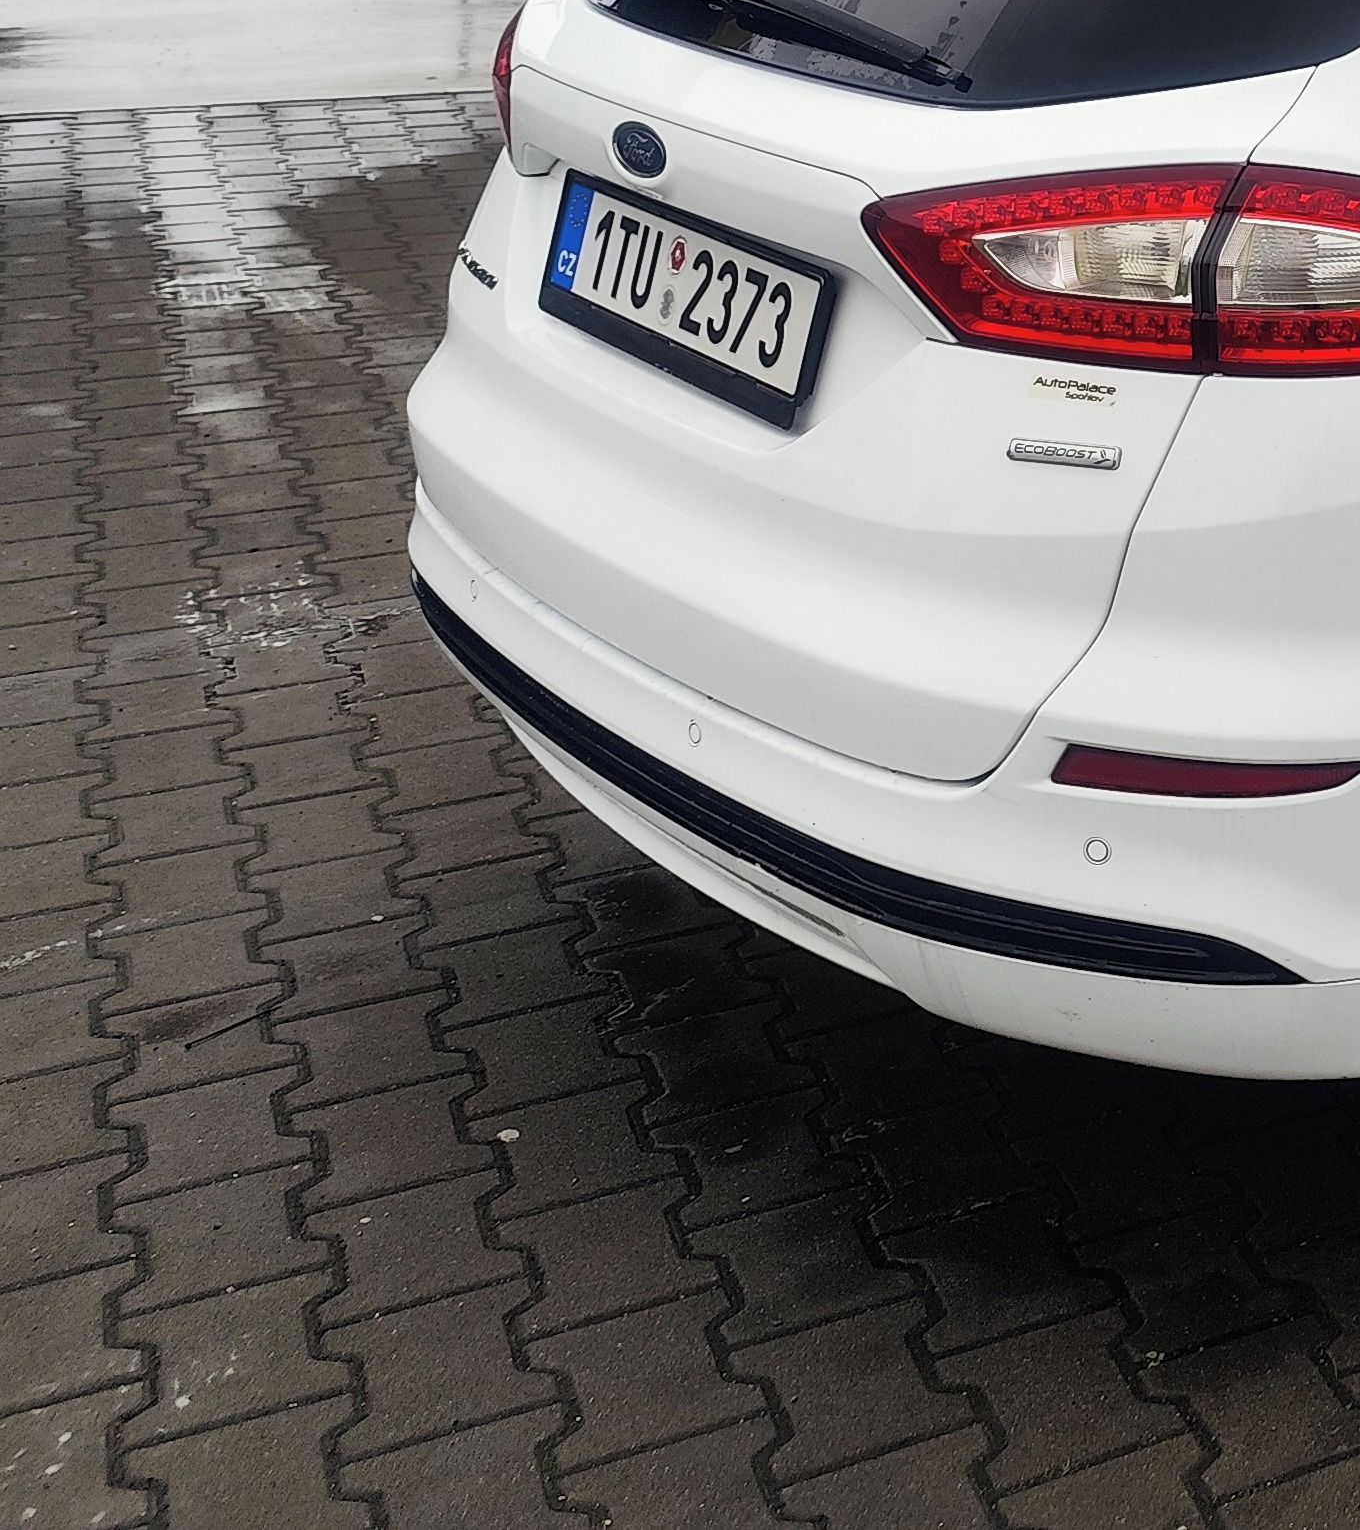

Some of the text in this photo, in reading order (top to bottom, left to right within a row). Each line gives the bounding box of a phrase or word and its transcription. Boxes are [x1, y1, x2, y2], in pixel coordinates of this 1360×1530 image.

[623, 132, 655, 167] Ford
[557, 250, 577, 277] CZ
[592, 209, 664, 310] 1TU
[678, 249, 793, 369] 2373
[1032, 376, 1117, 395] AutoPalace
[1013, 442, 1098, 460] ECOBOOST
